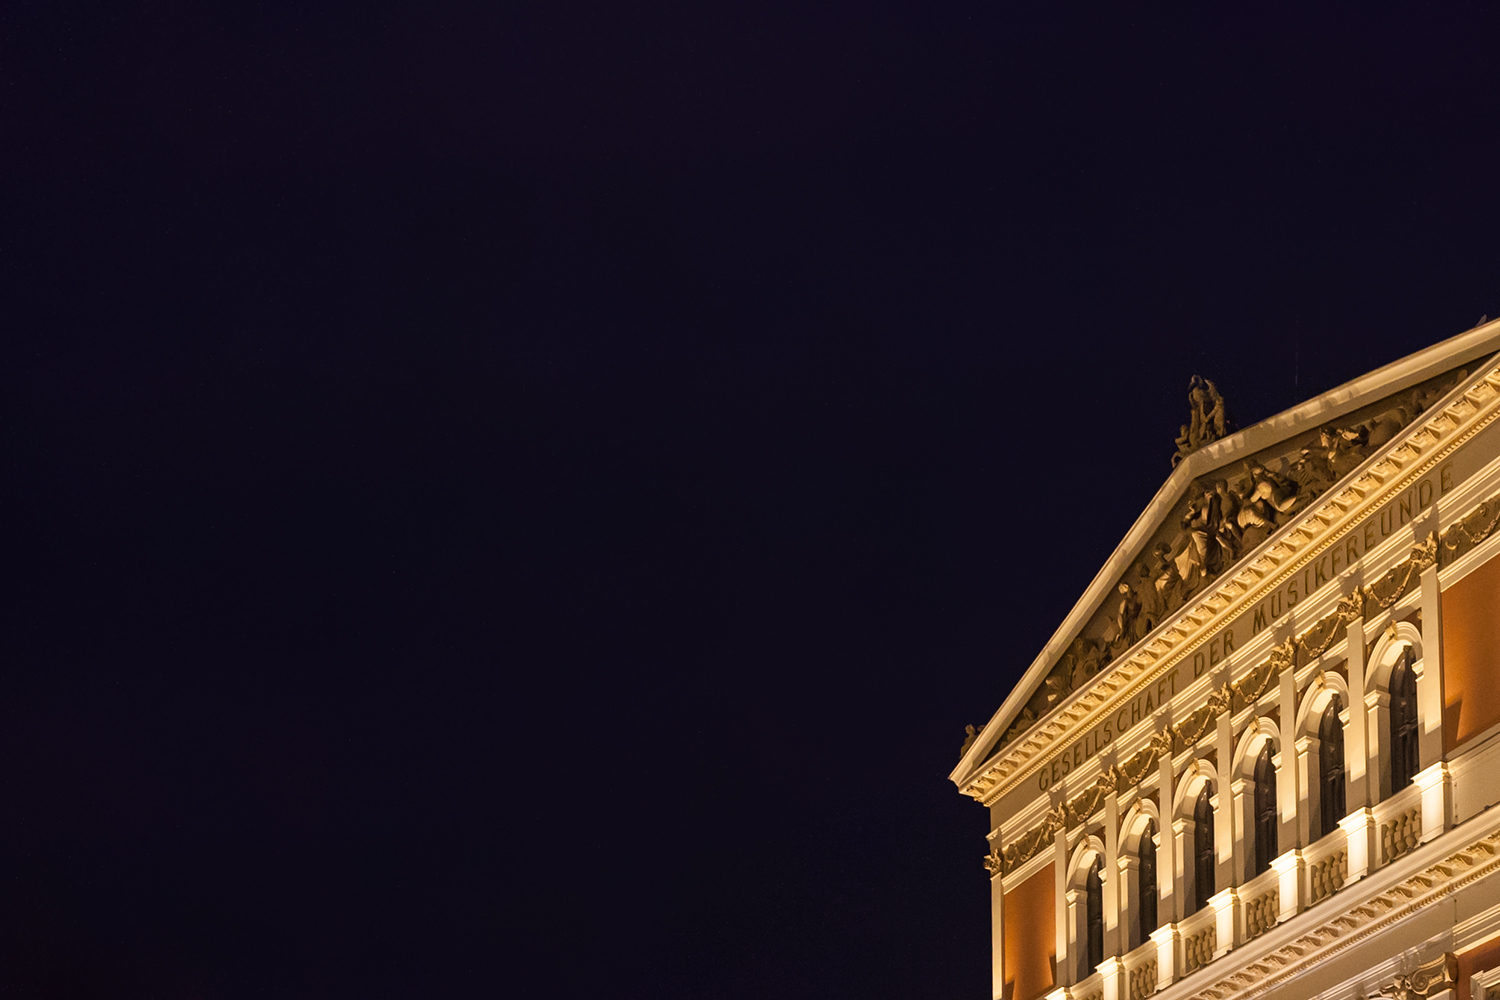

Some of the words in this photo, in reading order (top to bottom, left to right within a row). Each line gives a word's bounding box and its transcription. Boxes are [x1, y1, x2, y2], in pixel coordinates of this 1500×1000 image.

[1038, 671, 1180, 792] GESELLSCHAFT
[1193, 629, 1235, 679] DER
[1252, 462, 1454, 636] MUSIKFREUNDE
